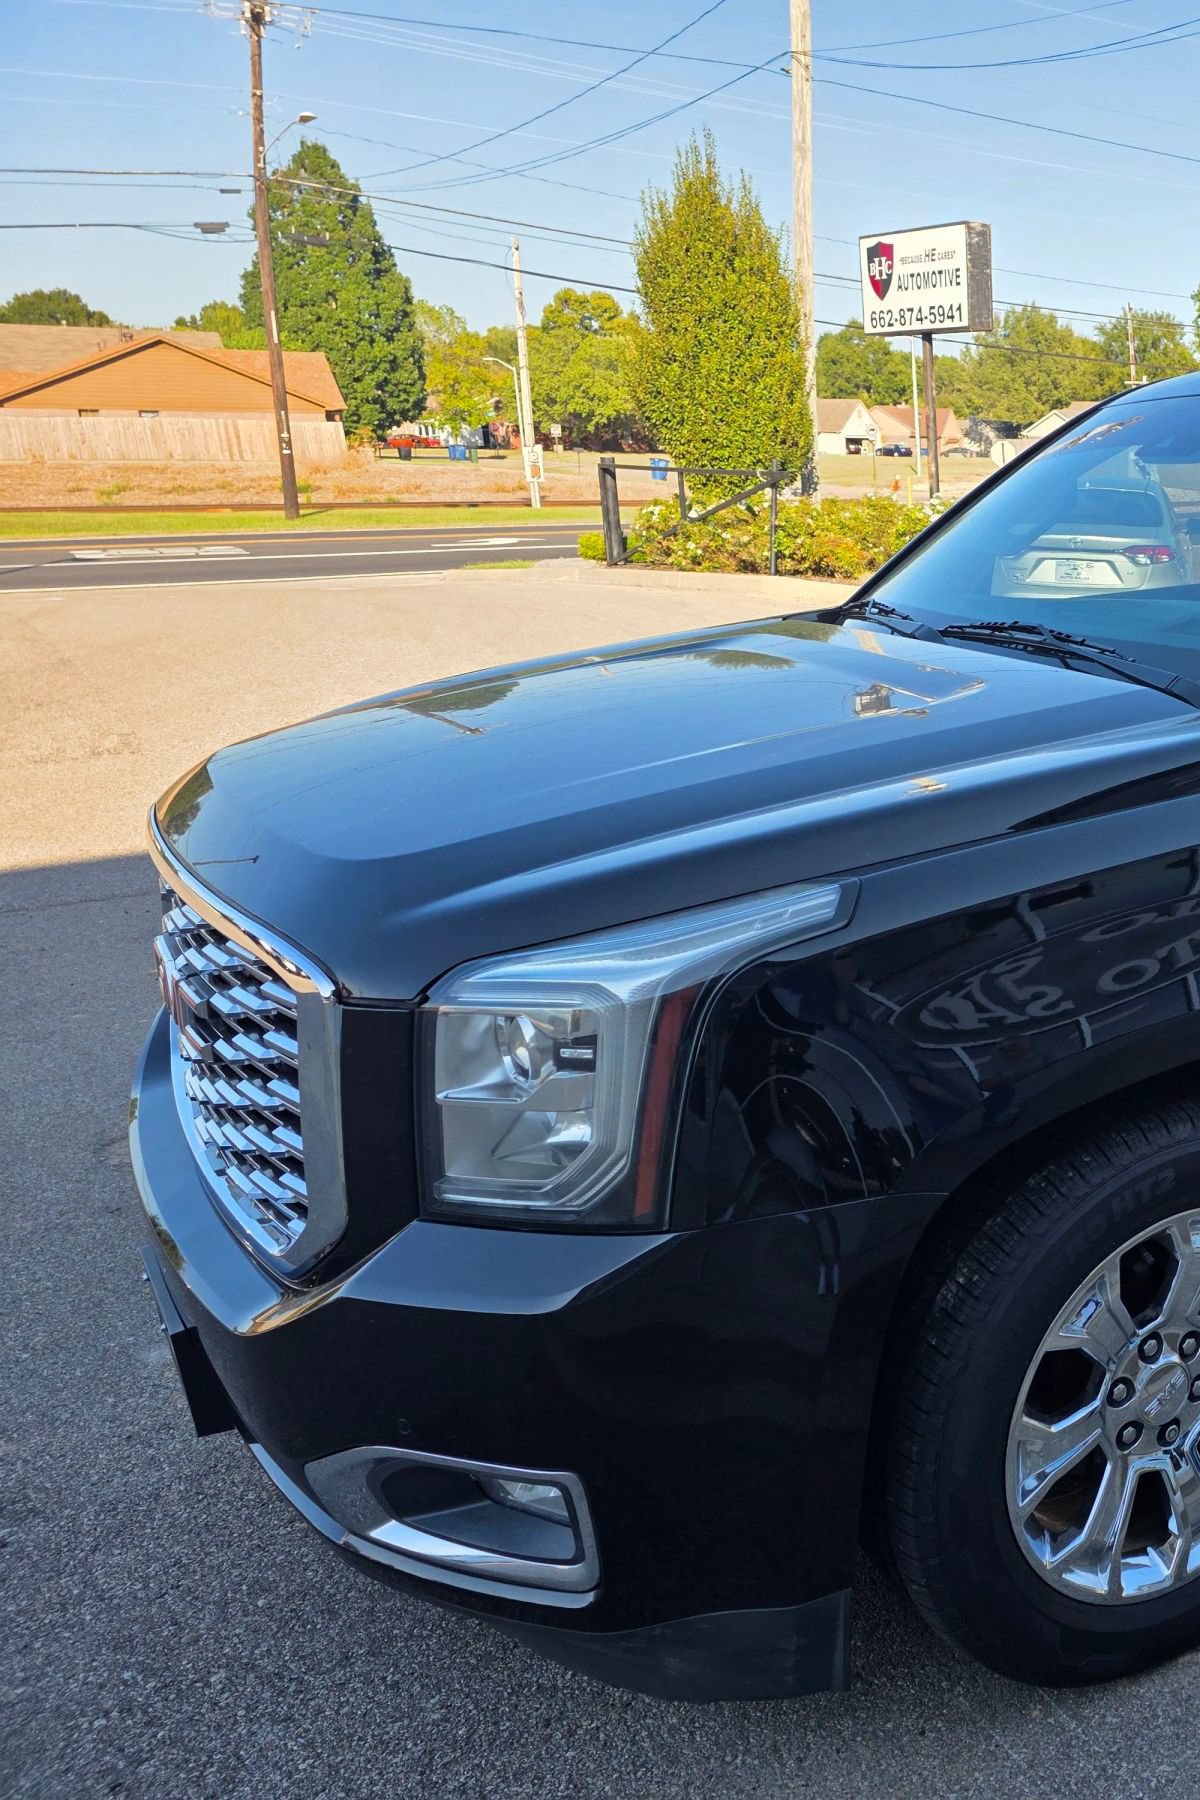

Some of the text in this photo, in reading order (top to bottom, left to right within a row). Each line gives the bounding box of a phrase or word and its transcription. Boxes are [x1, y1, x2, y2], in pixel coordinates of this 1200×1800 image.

[924, 248, 936, 263] HE
[897, 268, 961, 292] AUTOMOTIVE
[870, 303, 963, 329] 662-874-5941
[1144, 1368, 1186, 1418] GMC
